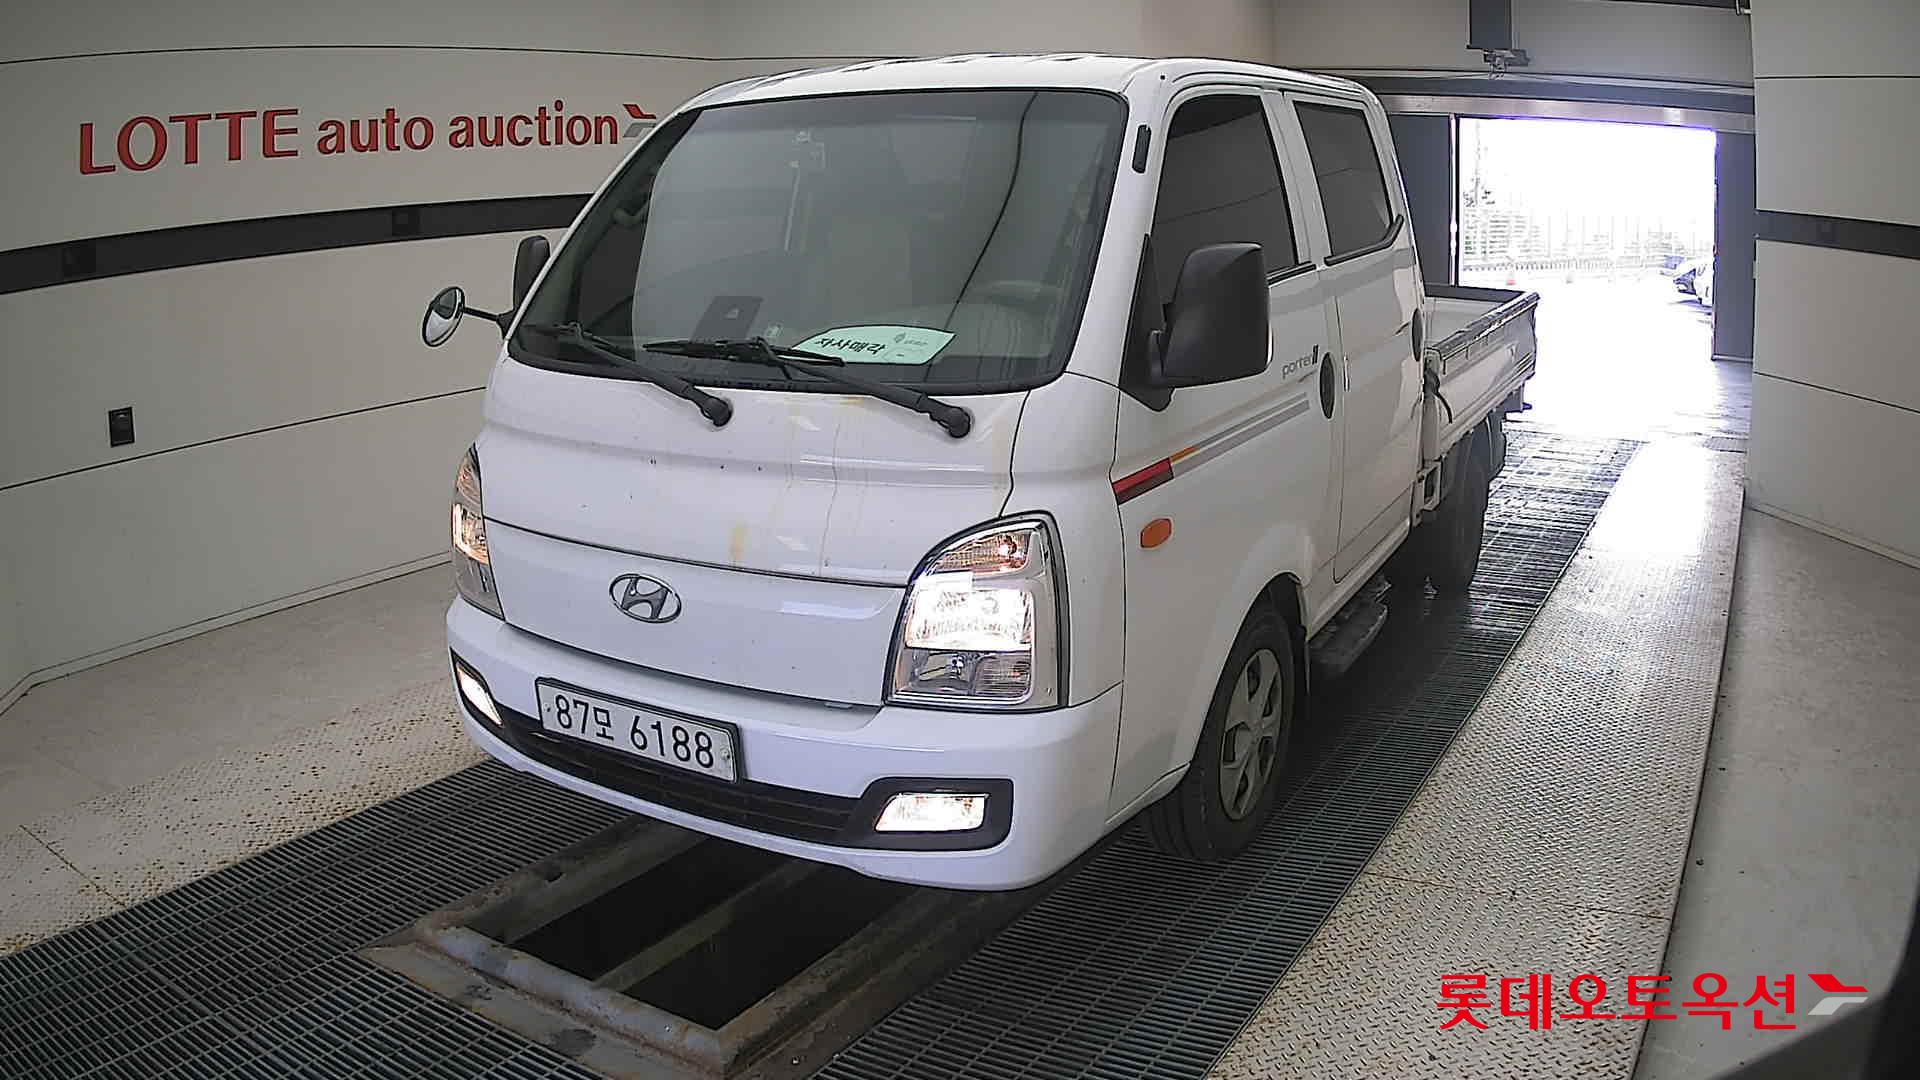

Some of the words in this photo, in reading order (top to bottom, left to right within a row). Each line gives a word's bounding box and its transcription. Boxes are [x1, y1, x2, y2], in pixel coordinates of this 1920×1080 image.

[79, 108, 299, 175] LOTTE
[317, 107, 434, 155] auto
[448, 99, 619, 148] auction
[555, 694, 614, 741] 87모
[630, 715, 714, 769] 6188
